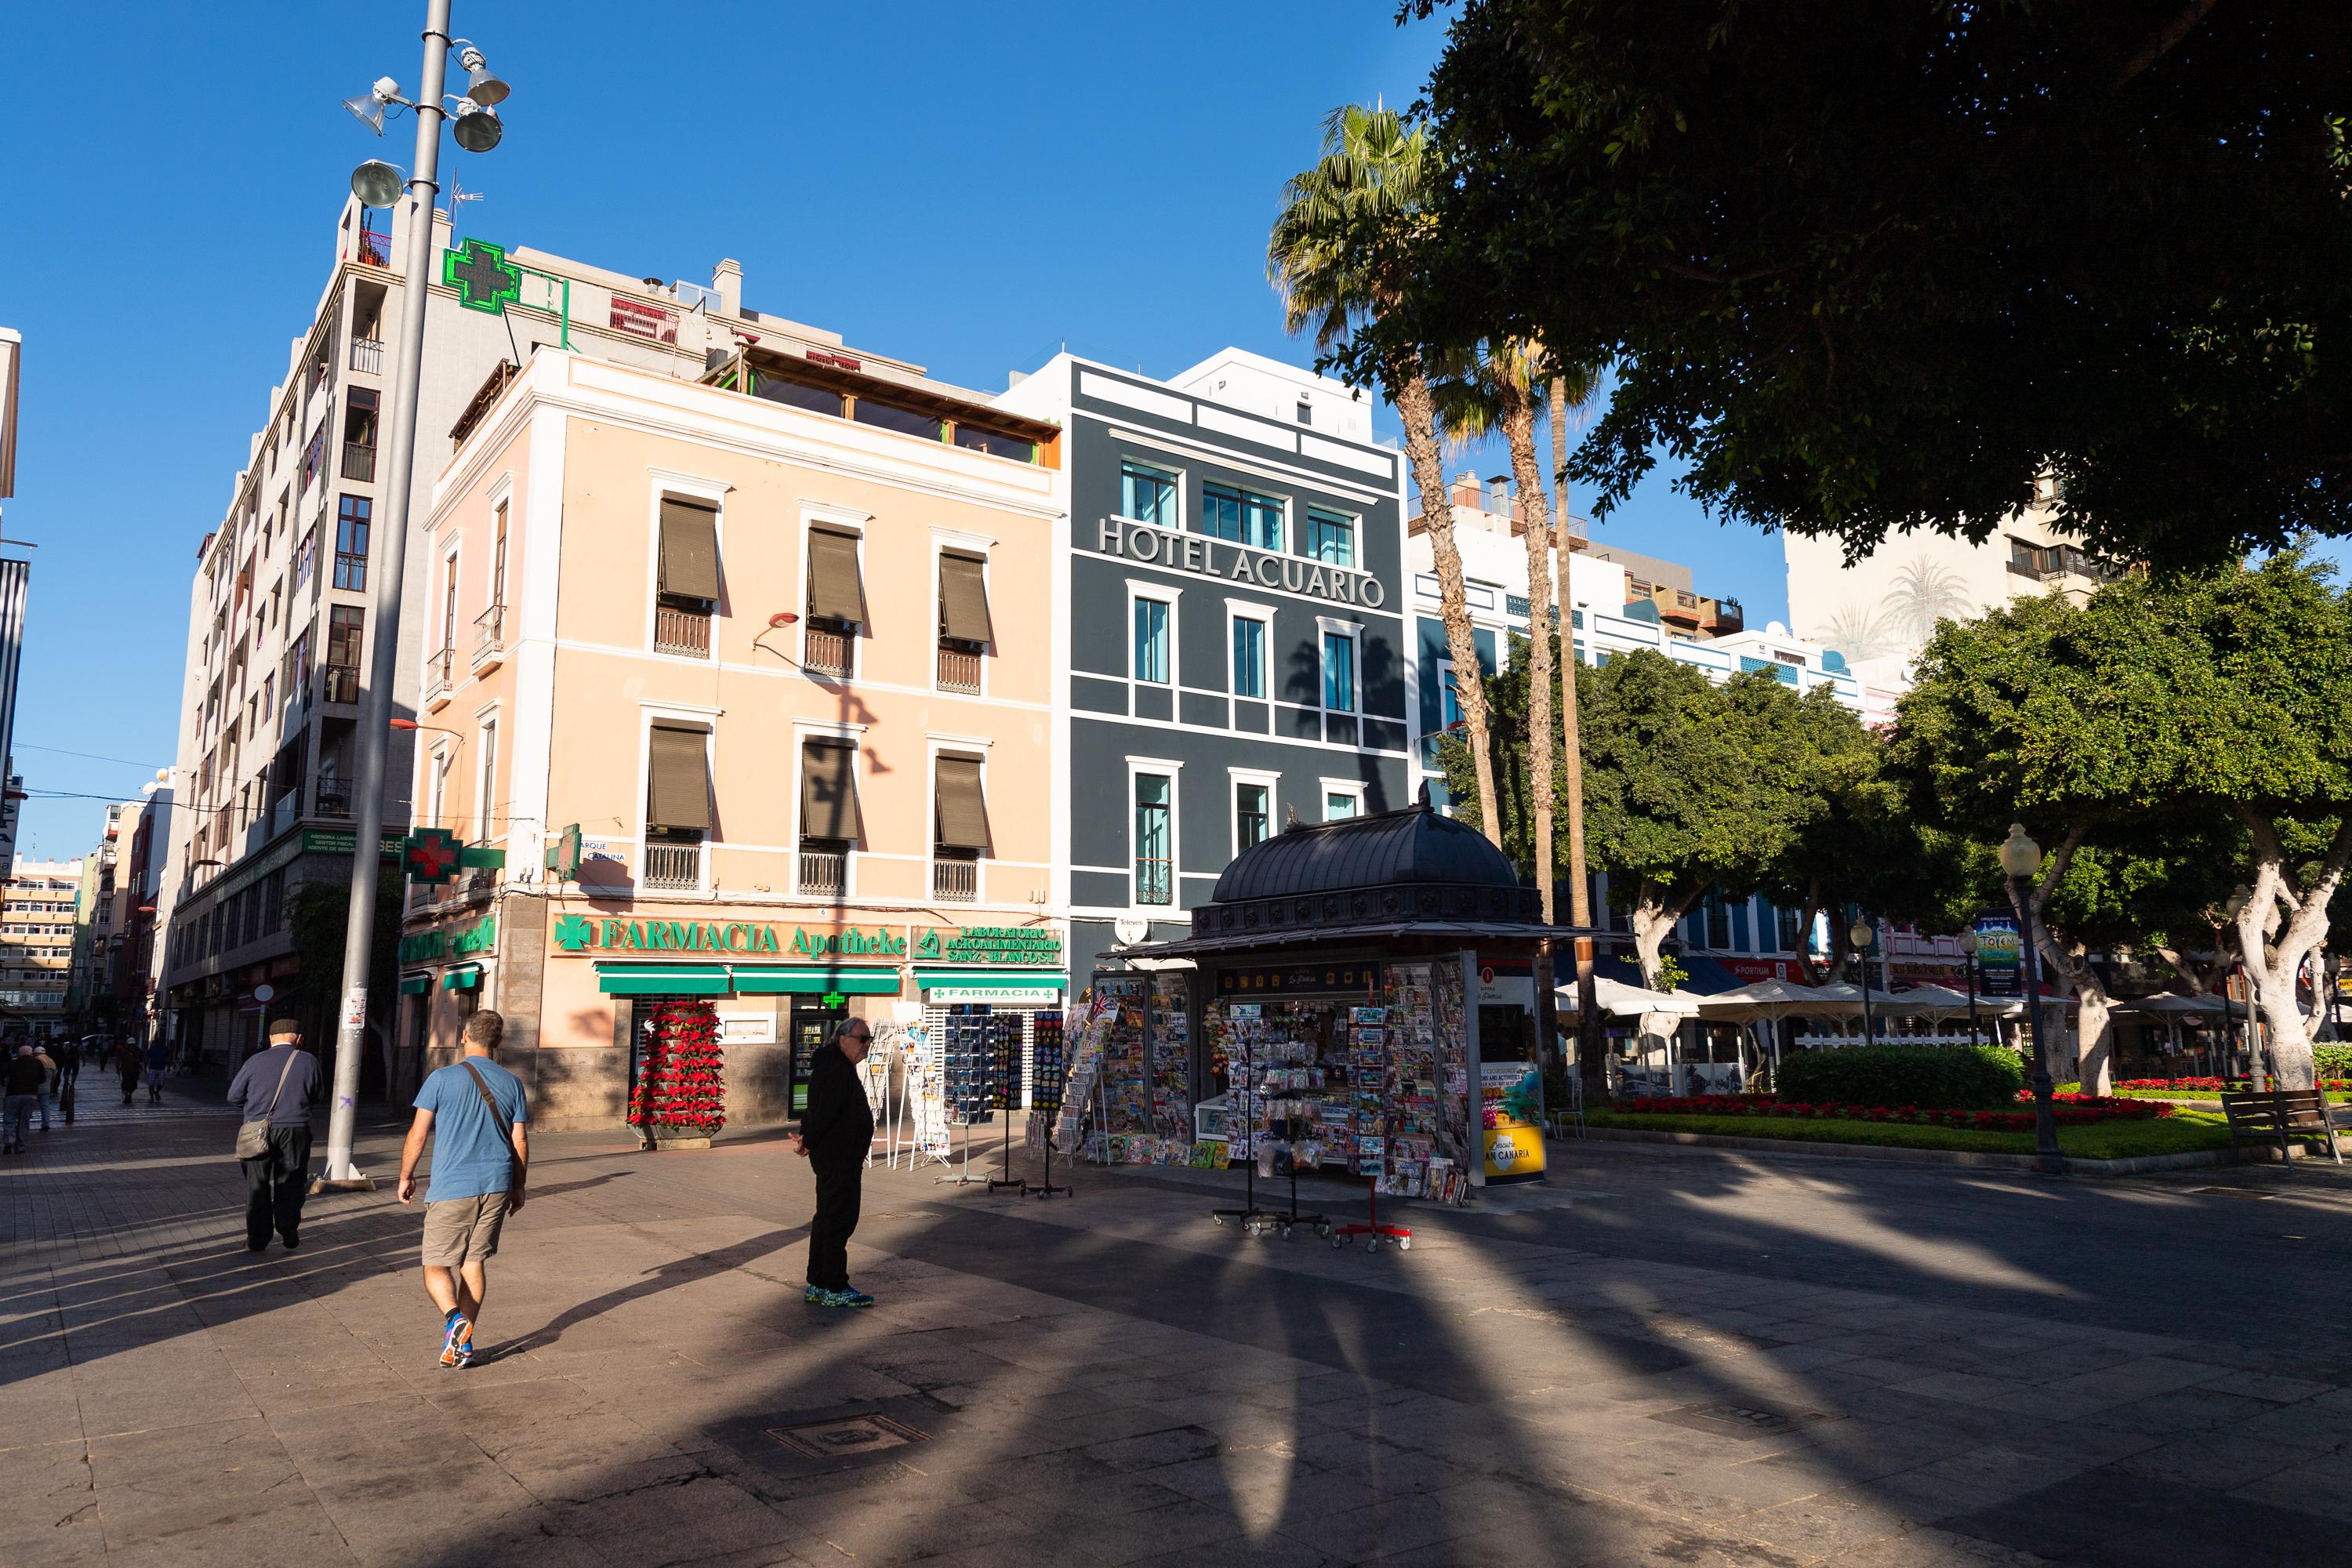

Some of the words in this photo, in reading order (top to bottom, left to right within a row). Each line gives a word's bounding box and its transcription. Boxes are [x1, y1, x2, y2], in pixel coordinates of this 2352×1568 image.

[1099, 518, 1221, 576] HOTEL
[1231, 549, 1385, 608] ACUARIO
[587, 852, 625, 861] CATALINA
[960, 926, 1047, 939] LABORATORIO
[601, 919, 779, 953] FARMACIA
[789, 925, 907, 960] Apotheke
[946, 938, 1062, 951] AGROALIMENTARIO
[1979, 933, 2015, 949] TOTEM
[947, 951, 981, 962] SANZ
[1733, 964, 1769, 975] SPORTIUM
[1485, 1151, 1496, 1161] AN
[1498, 1149, 1530, 1160] CANARIA
